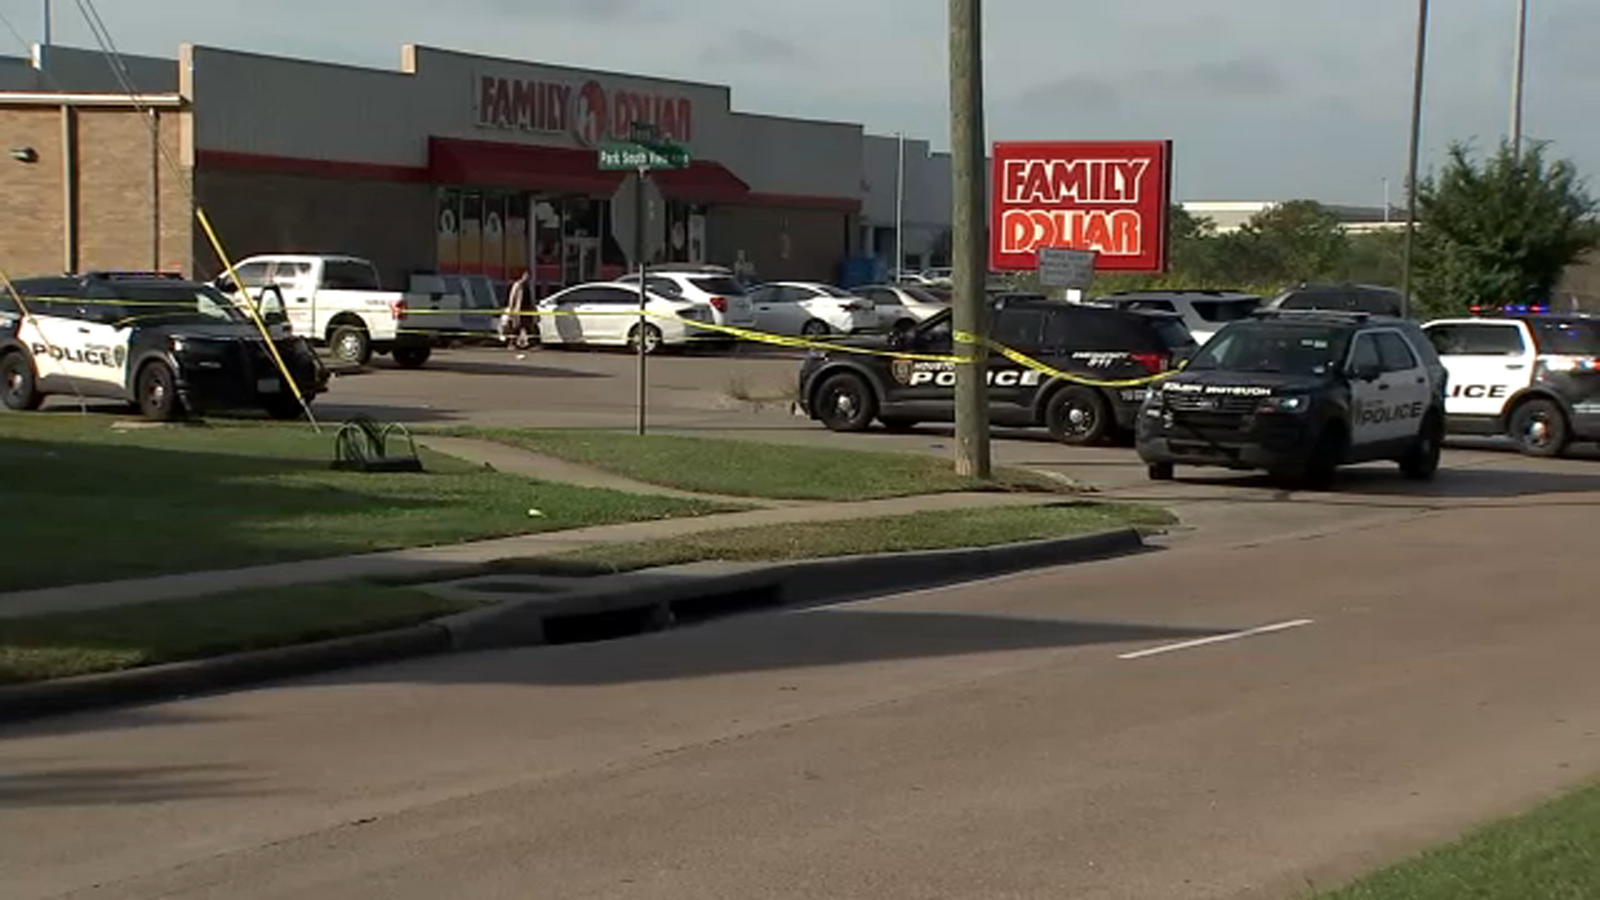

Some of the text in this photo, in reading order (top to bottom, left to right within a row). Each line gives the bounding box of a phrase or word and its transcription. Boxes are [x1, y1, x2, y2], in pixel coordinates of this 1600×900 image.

[478, 76, 692, 142] FAMILY DOLLAR
[601, 150, 620, 165] Park
[621, 150, 647, 165] South
[1003, 159, 1150, 203] FAMILY
[1001, 209, 1141, 255] DOLLAR
[31, 342, 115, 368] POLICE
[914, 362, 955, 371] HOUSTO
[910, 371, 1039, 386] POICE
[1444, 384, 1508, 398] ICE
[1361, 402, 1422, 425] POLICE
